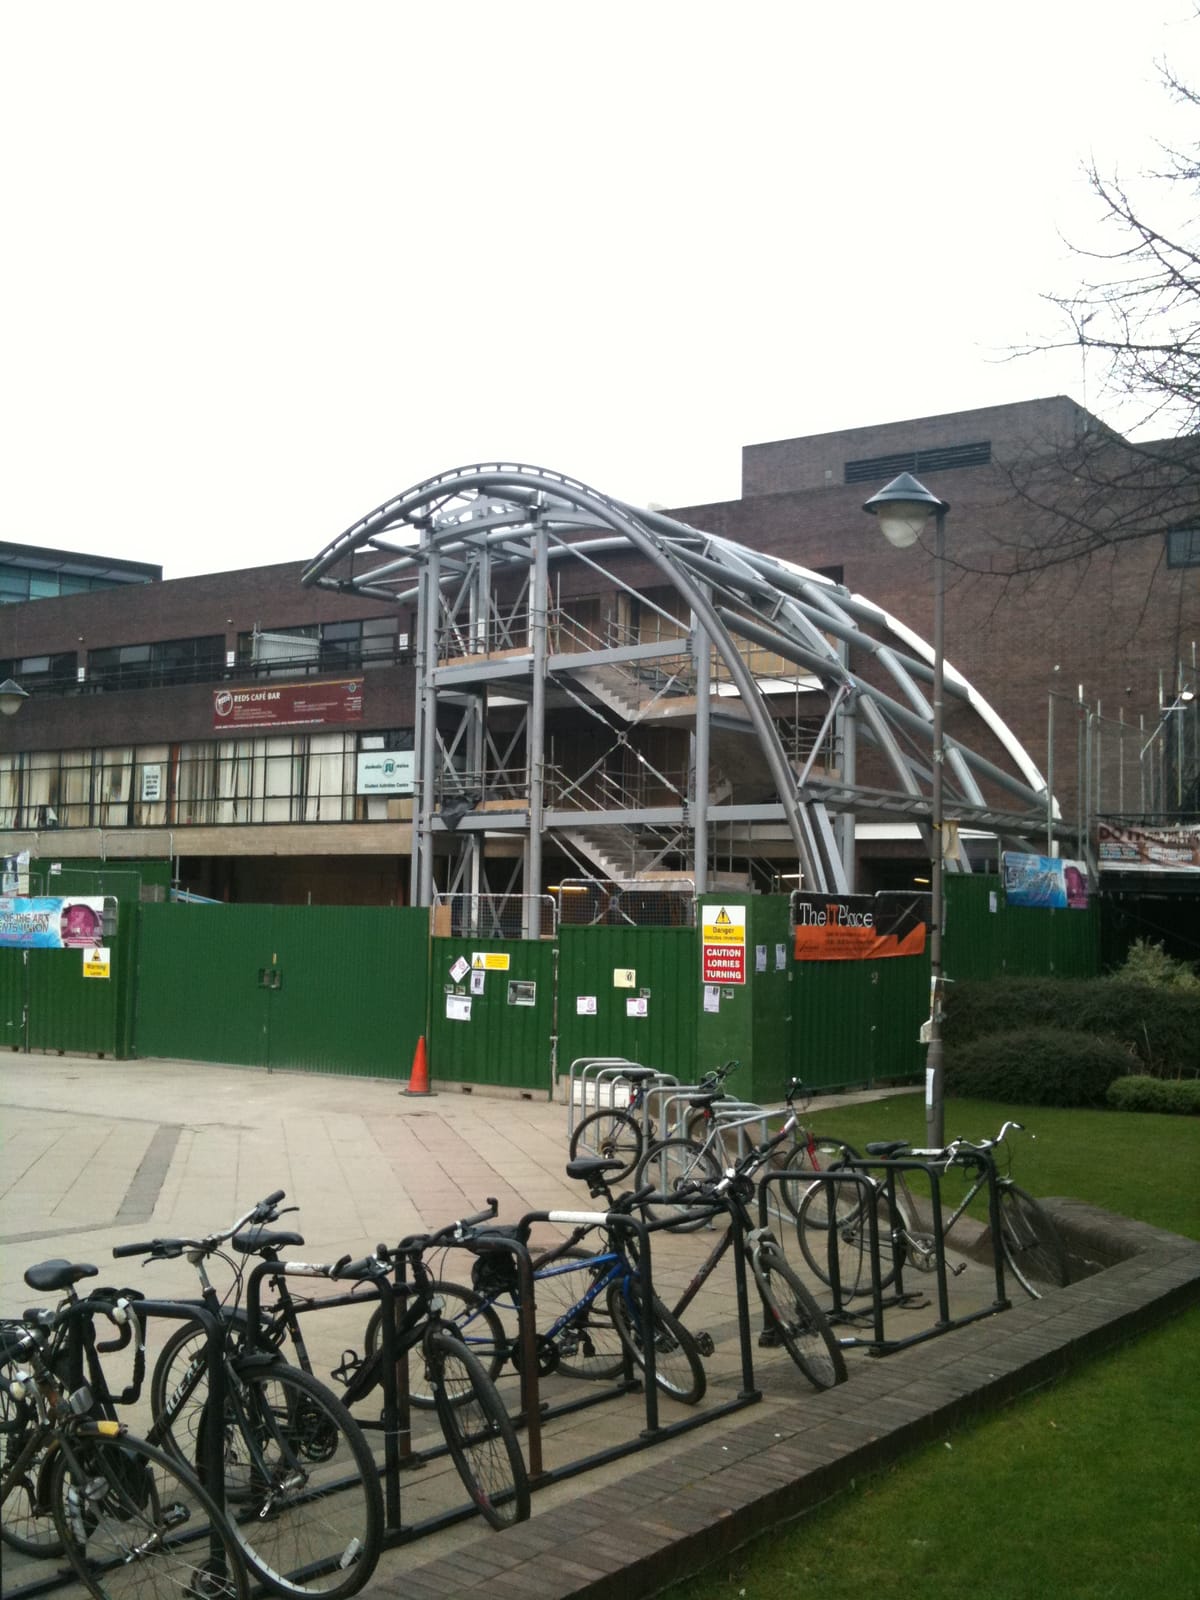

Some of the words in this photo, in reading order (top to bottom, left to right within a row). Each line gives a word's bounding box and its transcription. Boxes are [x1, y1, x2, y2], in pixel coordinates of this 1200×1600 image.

[251, 691, 266, 701] CAFÉ
[267, 692, 280, 700] BAR
[33, 913, 50, 922] ART
[799, 902, 826, 927] The
[838, 904, 873, 928] Place
[712, 926, 734, 935] Danger
[706, 948, 741, 957] CAUTION
[707, 959, 740, 968] LORRIES
[706, 970, 742, 979] TURNING
